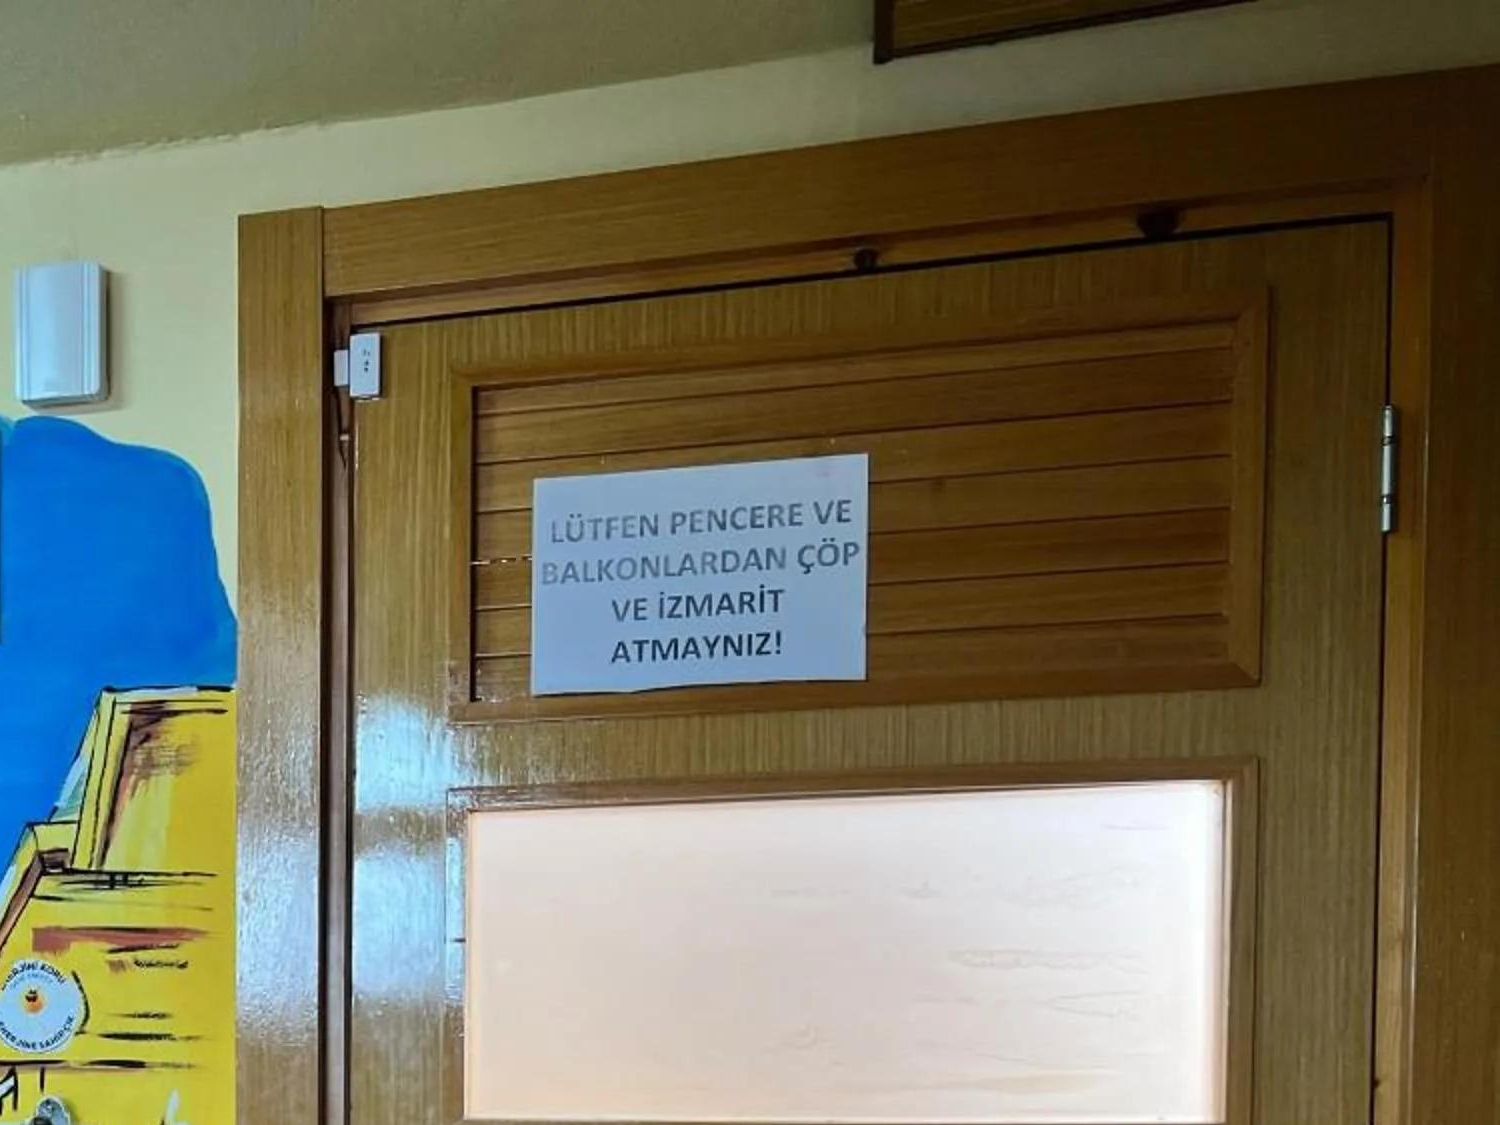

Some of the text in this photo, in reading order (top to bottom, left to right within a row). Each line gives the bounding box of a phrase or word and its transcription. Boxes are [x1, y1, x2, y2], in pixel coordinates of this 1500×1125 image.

[551, 499, 853, 543] LÜTFEN PENCERE VE
[541, 538, 860, 585] BALKONLARDAN ÇÖP
[611, 584, 785, 622] VE İZMARİT
[611, 630, 782, 664] ATMAYNIZ!
